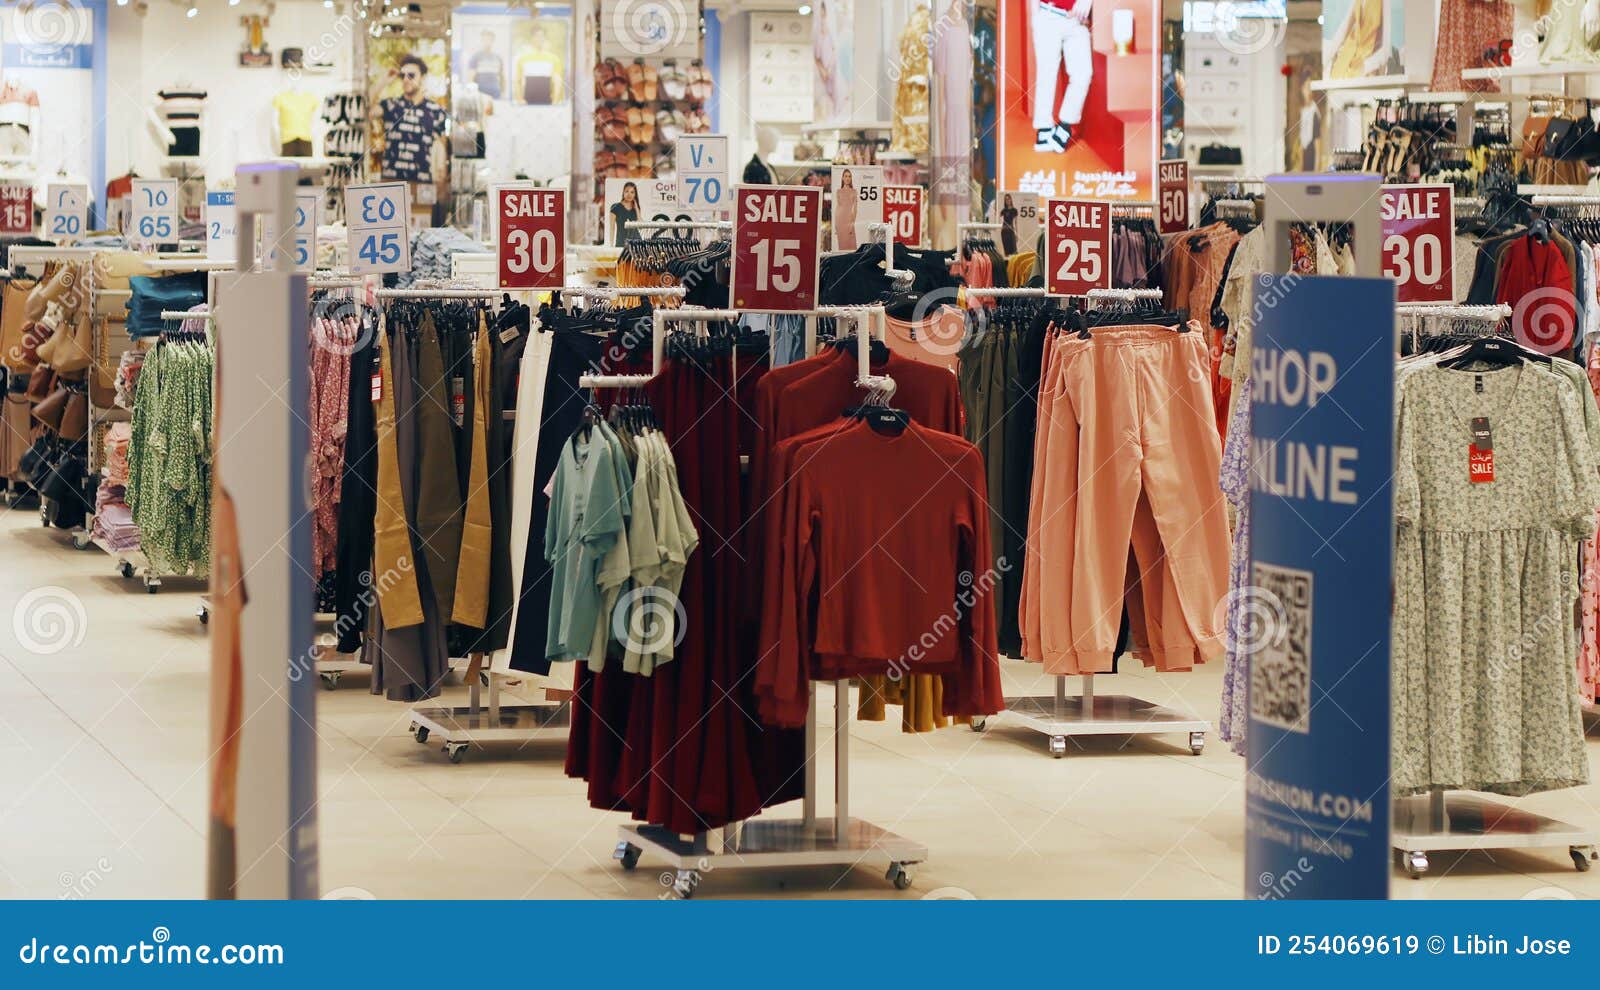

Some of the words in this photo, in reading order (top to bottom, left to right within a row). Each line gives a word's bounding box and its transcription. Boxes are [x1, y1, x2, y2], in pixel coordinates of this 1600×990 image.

[1161, 164, 1184, 183] SALE
[142, 188, 168, 207] ٦٥
[686, 178, 720, 204] 70
[859, 186, 878, 200] 55
[885, 189, 917, 205] SALE
[4, 205, 27, 229] 15
[362, 196, 396, 223] ٤٥
[504, 194, 556, 217] SALE
[744, 194, 808, 223] SALE
[1020, 206, 1036, 218] 55
[1054, 204, 1102, 229] SALE
[1162, 191, 1184, 224] 50
[1380, 192, 1440, 221] SALE
[53, 216, 80, 235] 20
[139, 216, 171, 237] 65
[212, 222, 221, 239] 2
[888, 210, 914, 238] 10
[358, 234, 401, 265] 45
[507, 229, 556, 274] 30
[1056, 239, 1102, 284] 25
[1383, 233, 1442, 286] 30
[750, 238, 801, 292] 15
[1471, 462, 1493, 474] SALE
